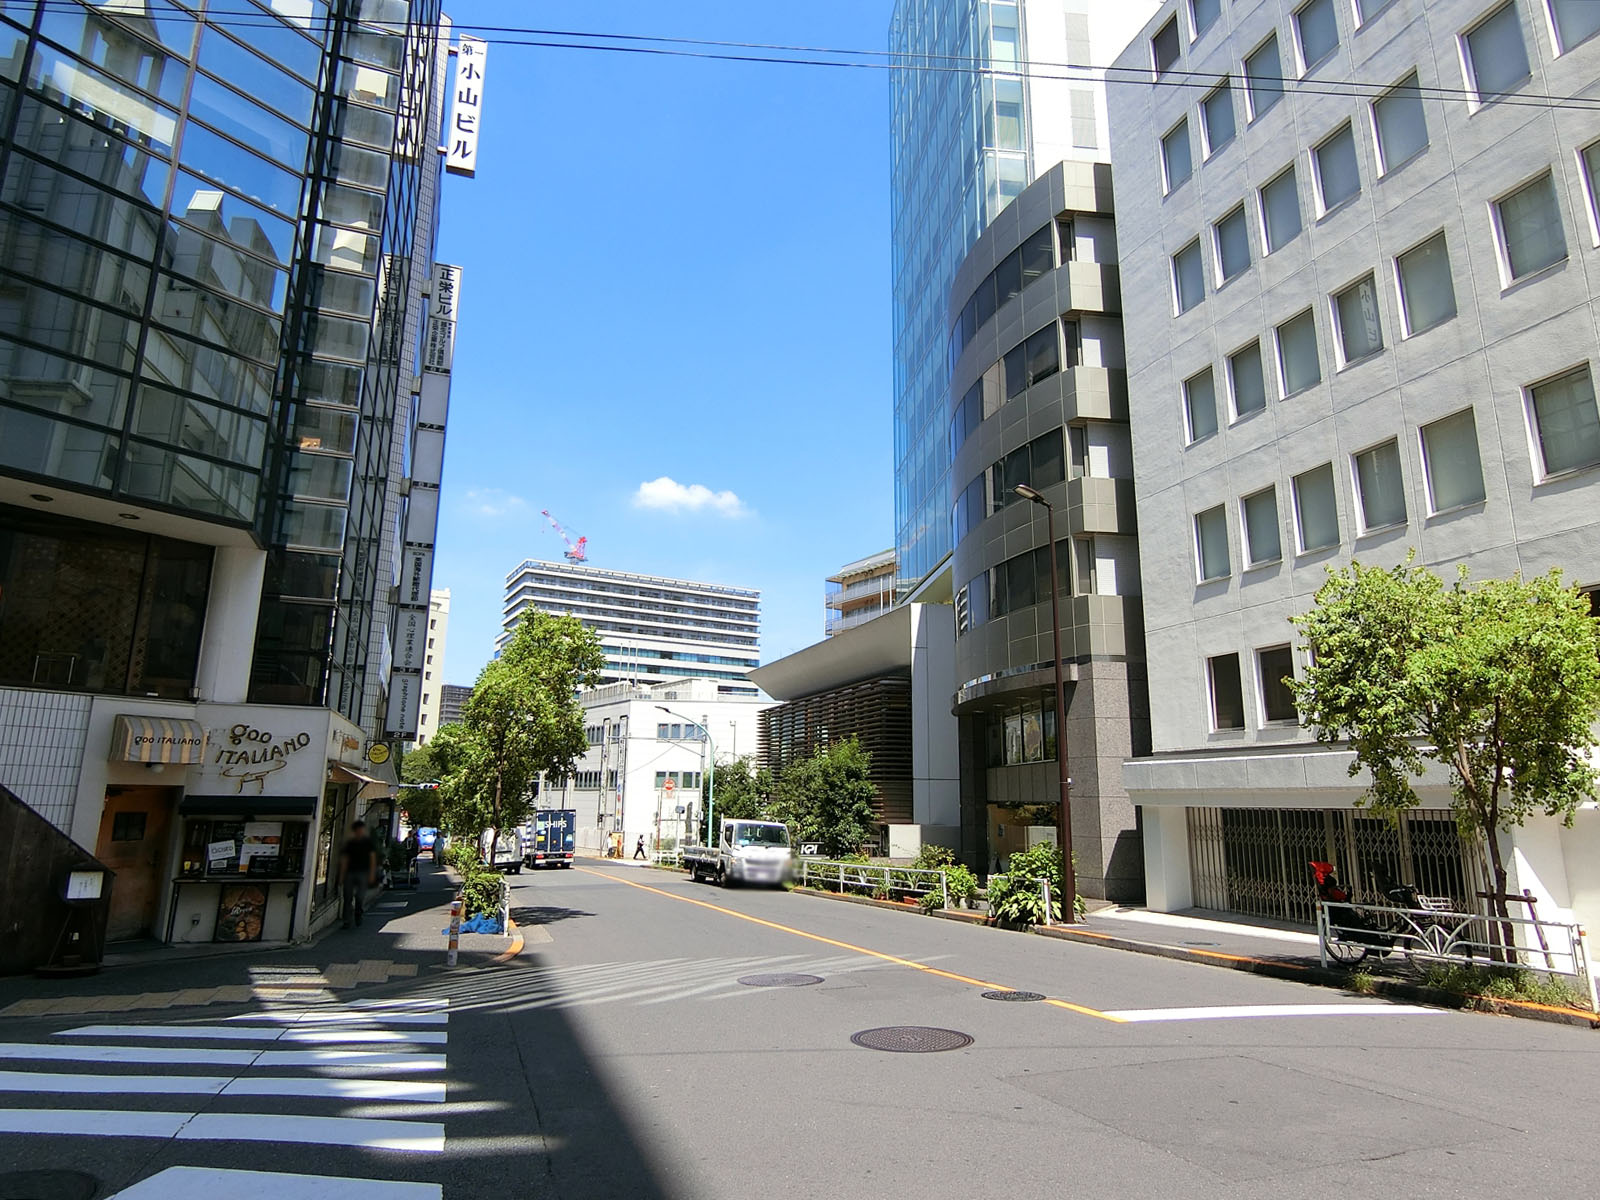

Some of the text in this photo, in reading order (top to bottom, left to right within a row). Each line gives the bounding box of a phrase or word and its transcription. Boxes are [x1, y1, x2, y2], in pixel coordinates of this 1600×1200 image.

[436, 267, 455, 315] 正栄ビル
[134, 735, 201, 746] goo ITALIANO
[230, 724, 272, 745] goo
[544, 820, 568, 828] SHIPS
